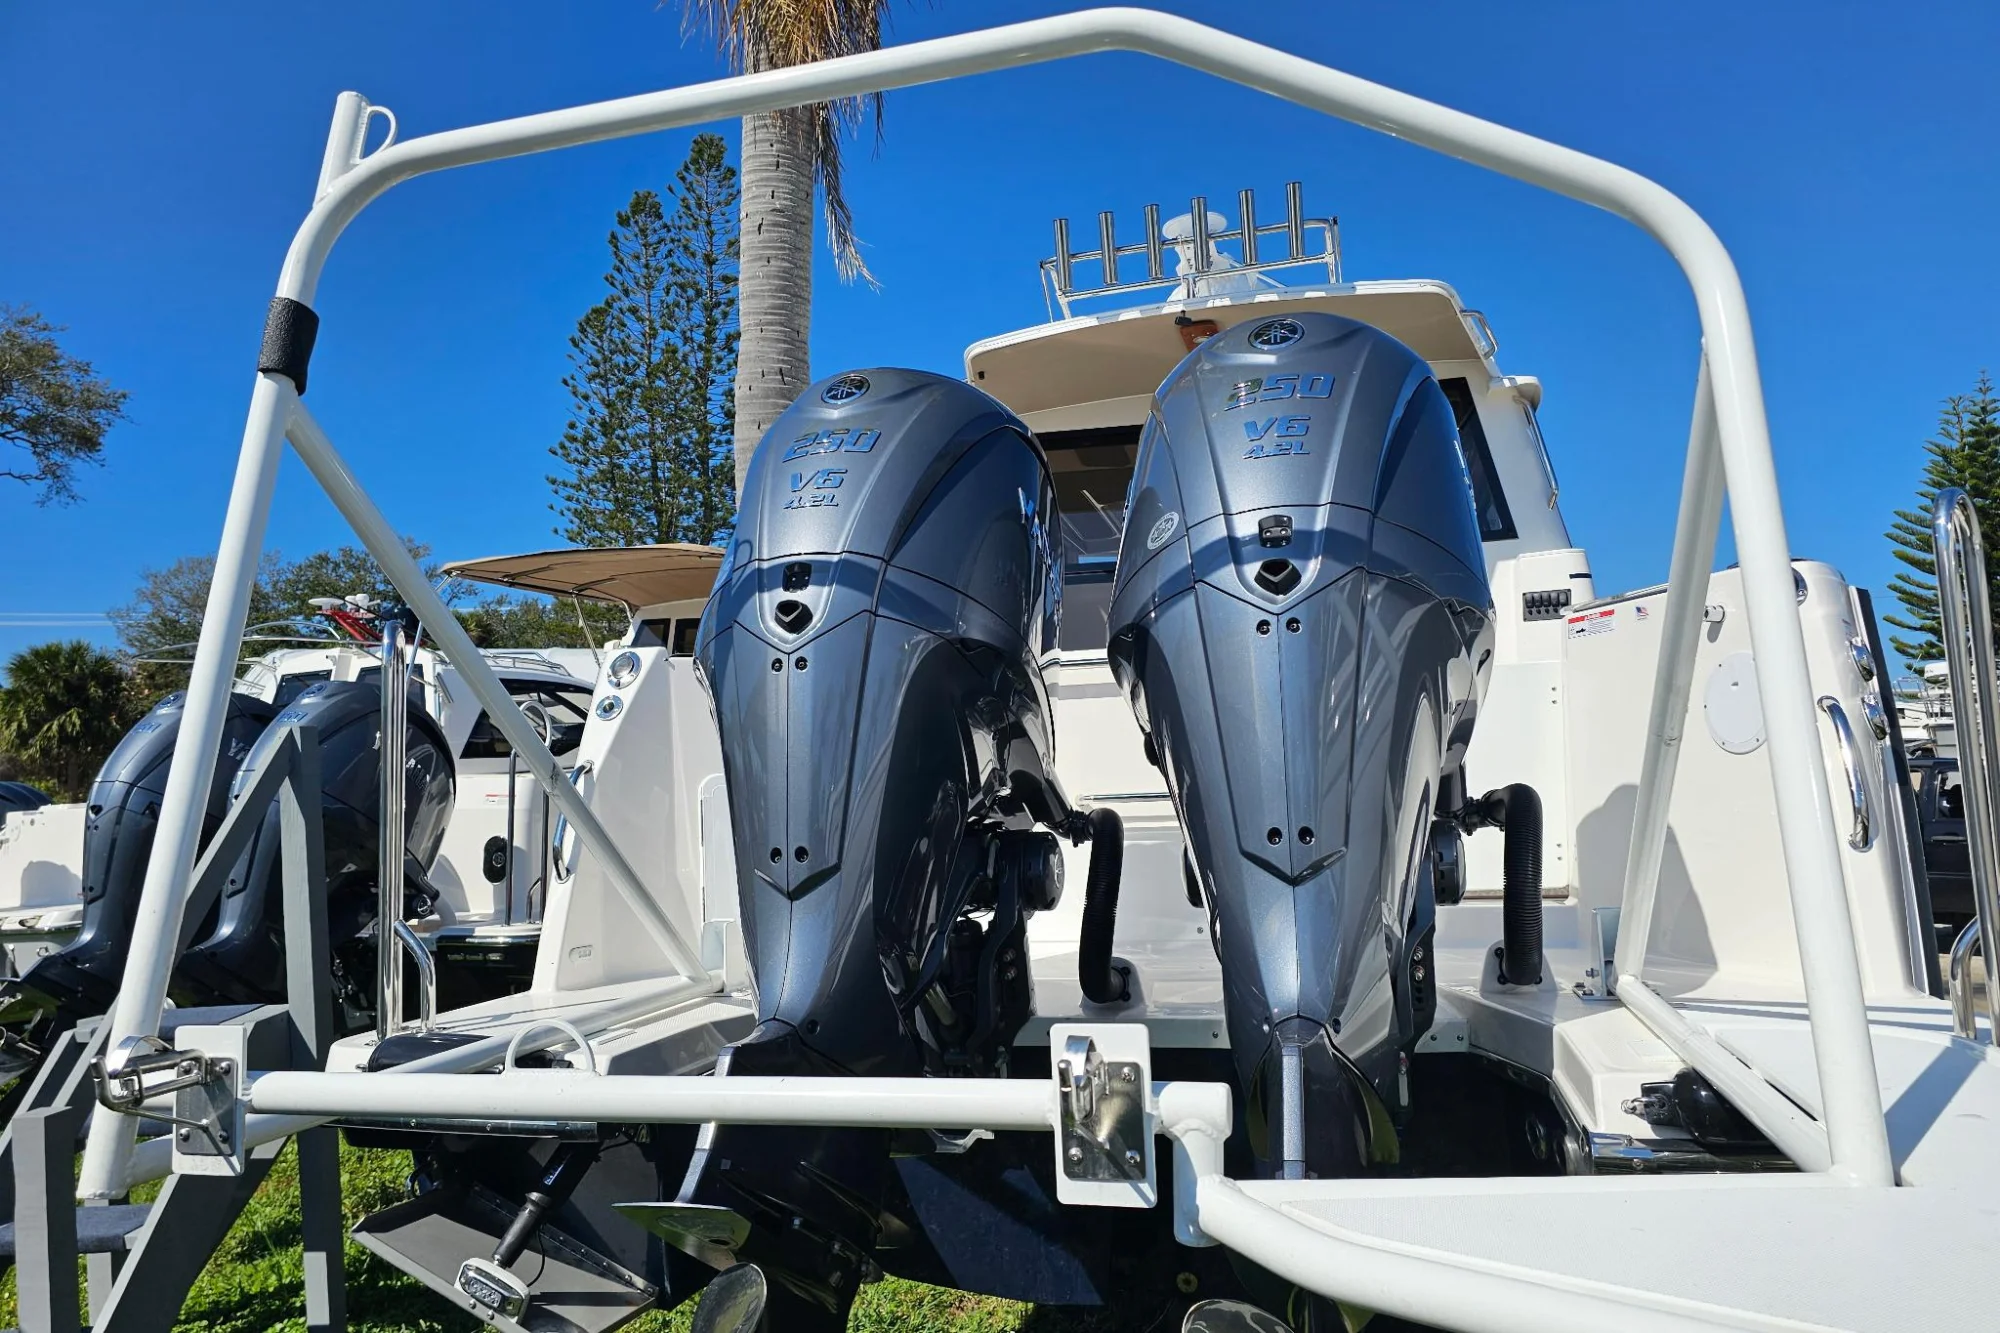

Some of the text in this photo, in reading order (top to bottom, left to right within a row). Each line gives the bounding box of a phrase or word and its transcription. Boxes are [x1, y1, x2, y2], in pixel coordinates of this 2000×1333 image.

[1224, 373, 1335, 411] 250
[1243, 414, 1311, 441] V6
[782, 428, 881, 463] 250
[1242, 441, 1310, 459] 4.2L
[790, 468, 848, 492] V6
[783, 493, 839, 509] 4.2L
